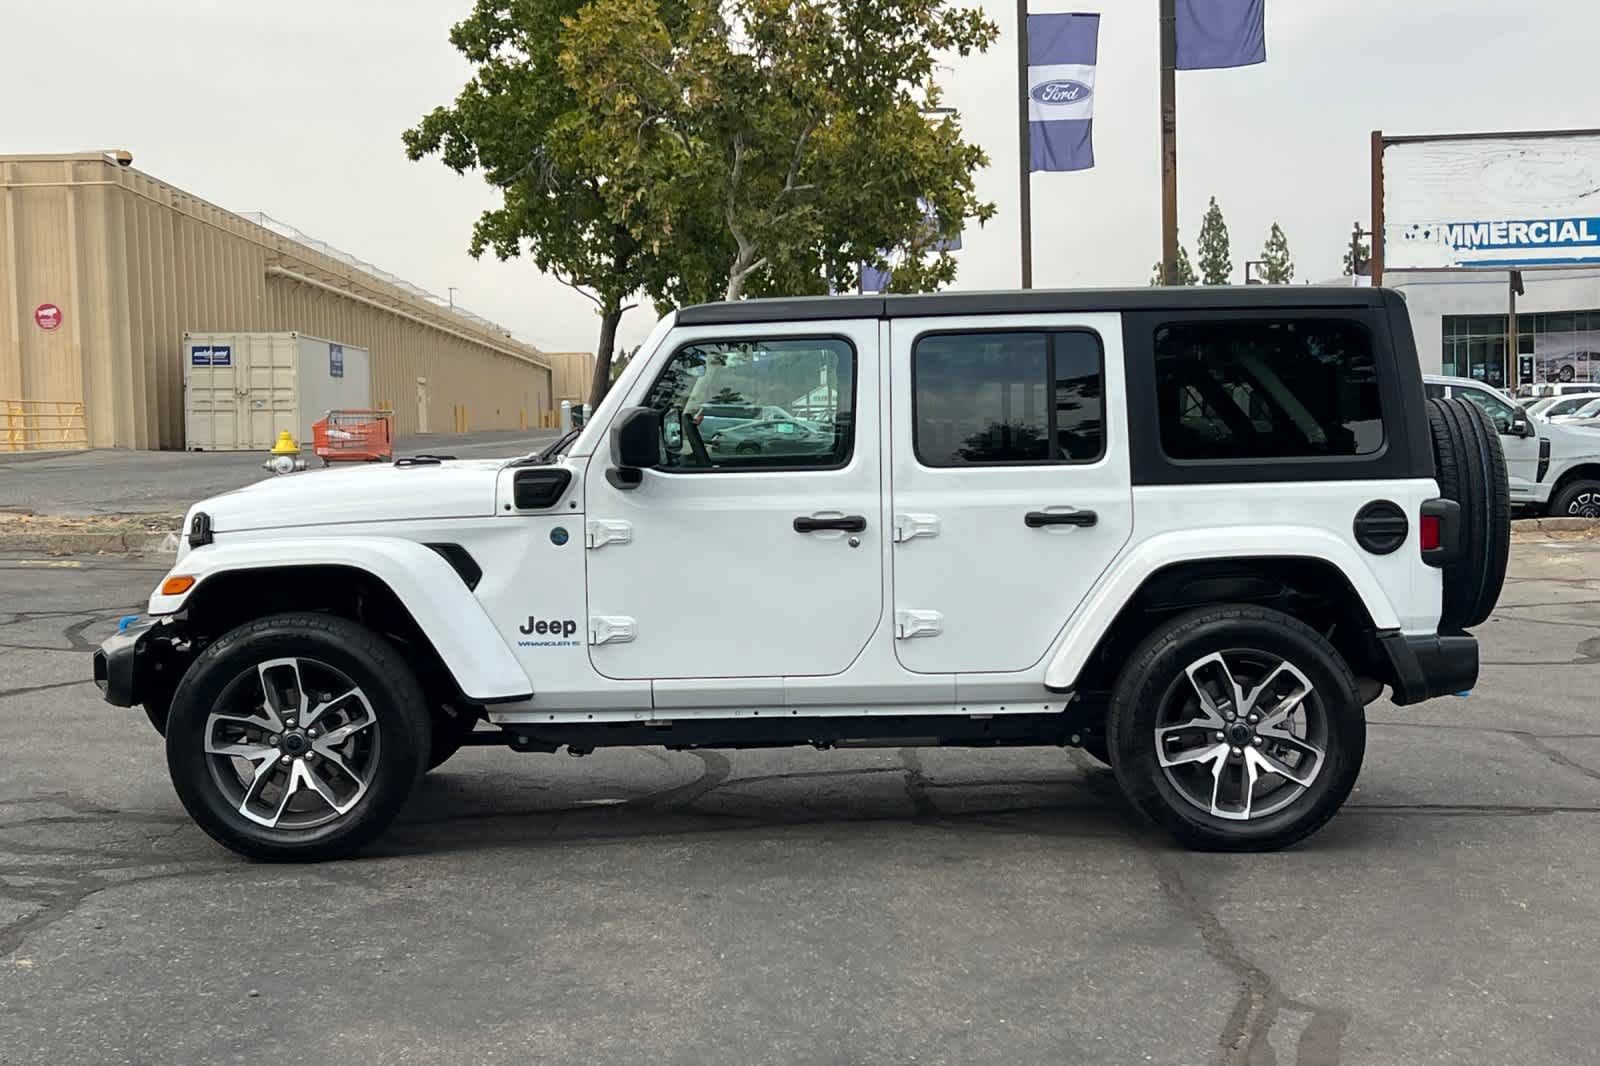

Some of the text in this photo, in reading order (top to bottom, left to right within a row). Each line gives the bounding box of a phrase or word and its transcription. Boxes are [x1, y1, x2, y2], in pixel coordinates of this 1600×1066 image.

[1042, 83, 1079, 101] Ford
[1404, 220, 1598, 246] MMERCIAL
[519, 615, 577, 638] Jeep
